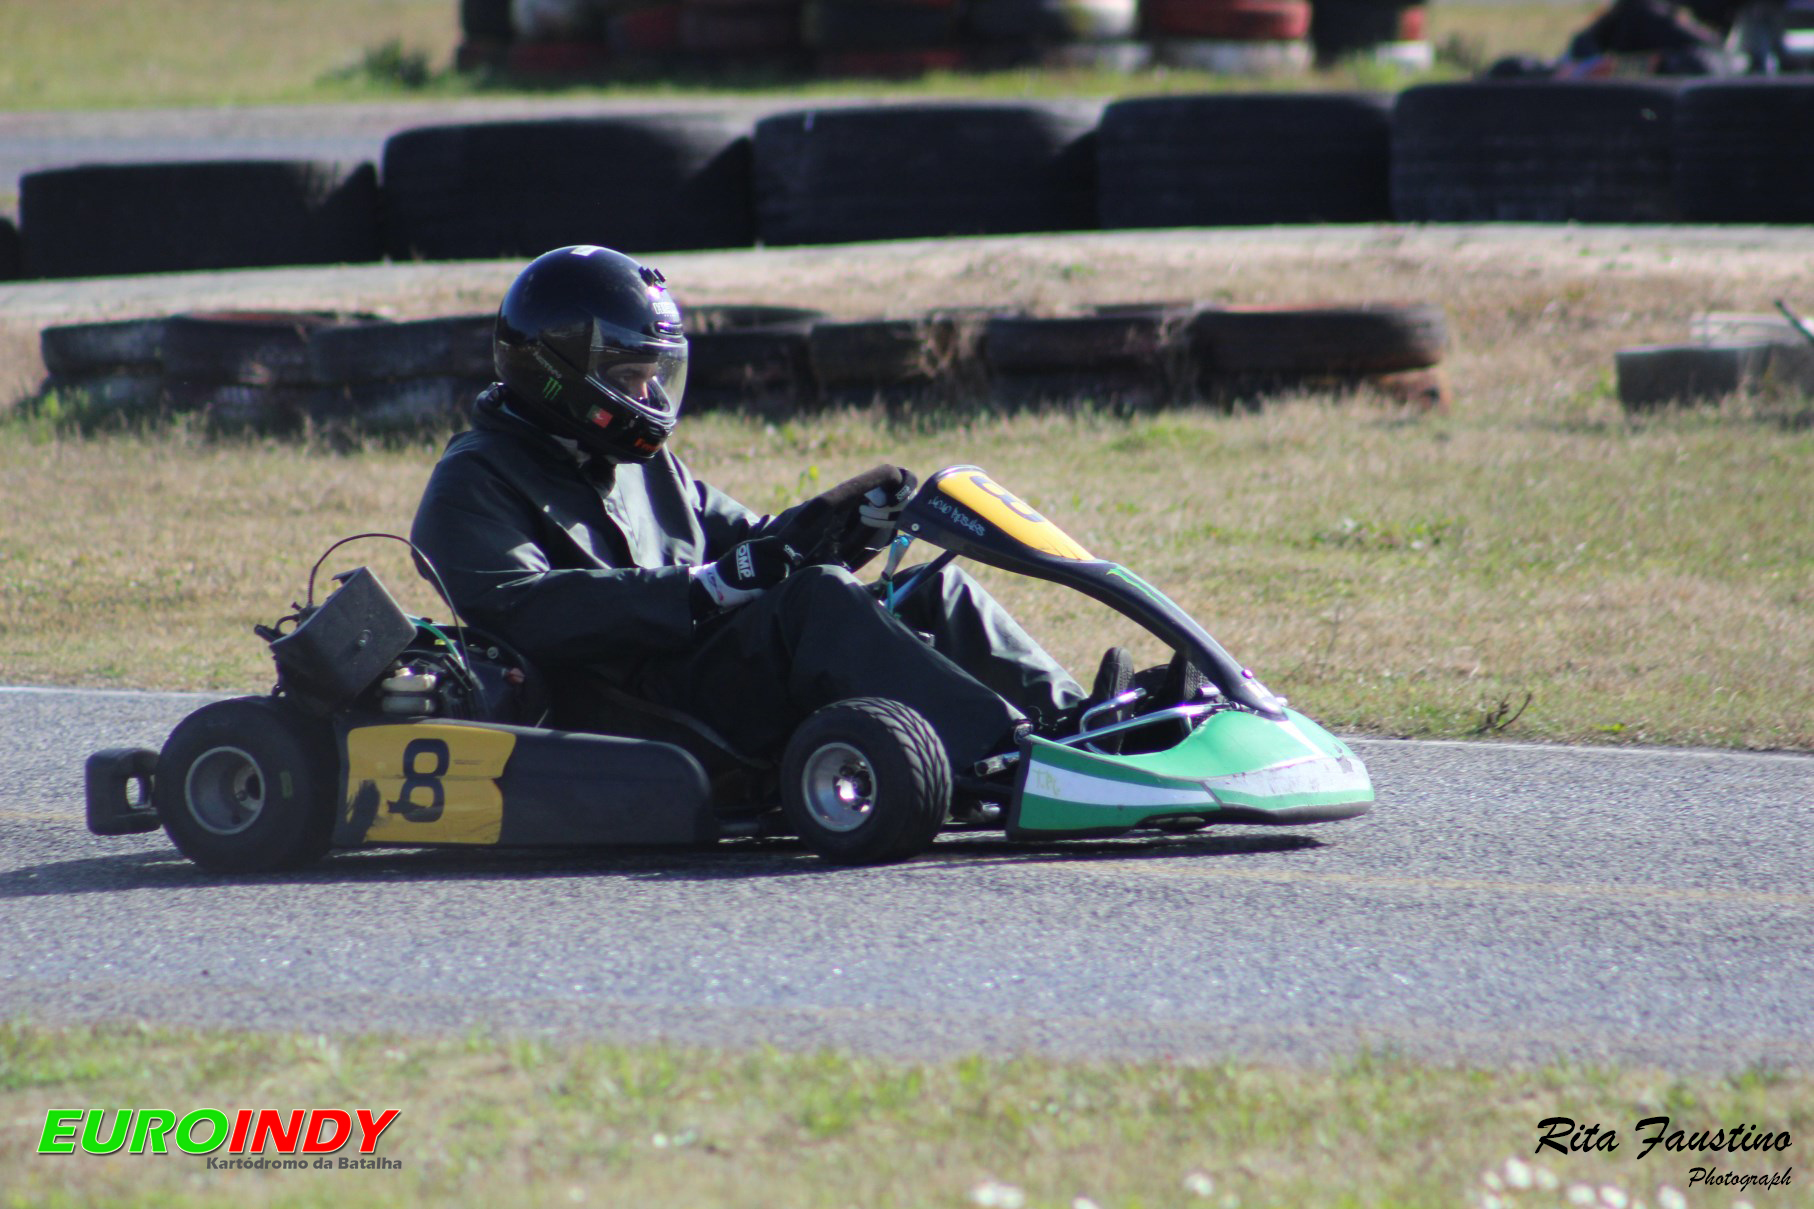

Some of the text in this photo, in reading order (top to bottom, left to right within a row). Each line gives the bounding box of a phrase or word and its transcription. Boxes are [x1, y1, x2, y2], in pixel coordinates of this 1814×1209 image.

[969, 475, 1046, 523] 8
[738, 544, 752, 578] OMP
[401, 738, 450, 823] 8
